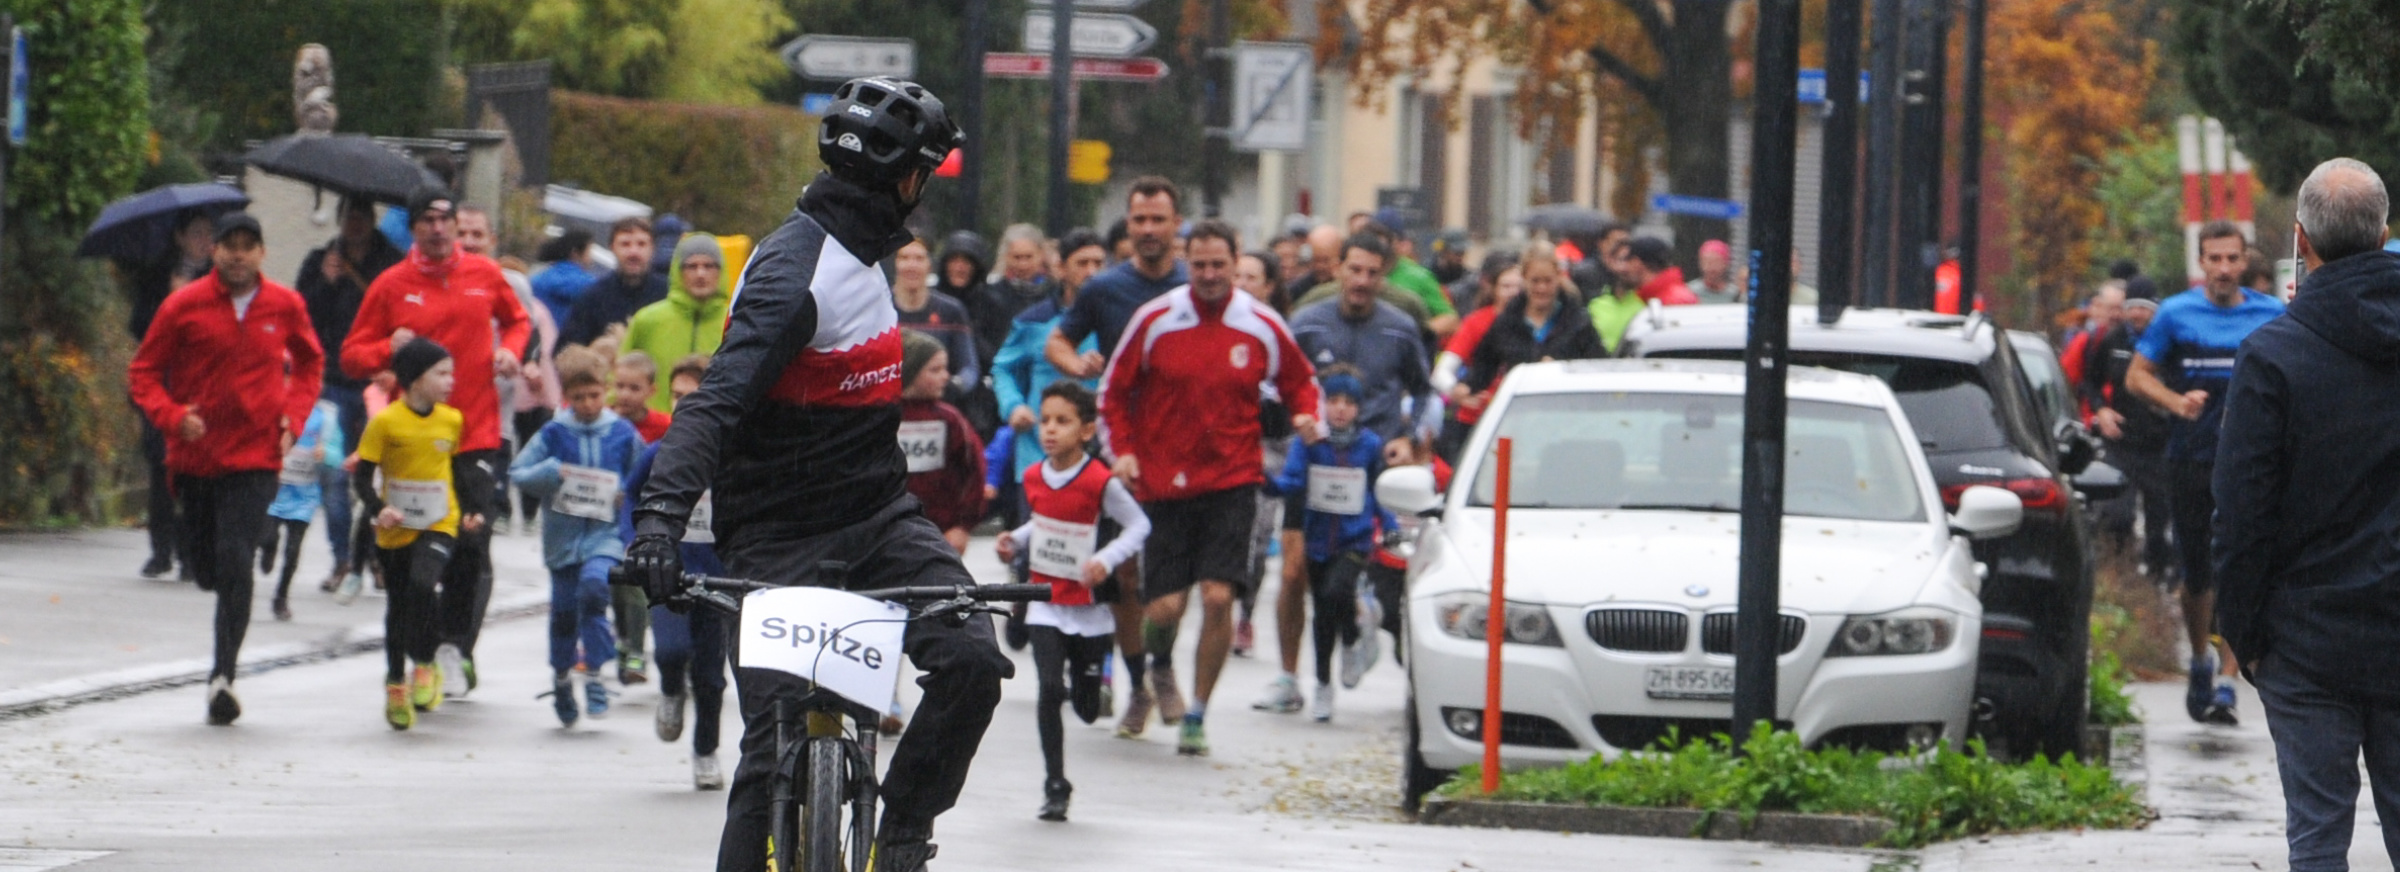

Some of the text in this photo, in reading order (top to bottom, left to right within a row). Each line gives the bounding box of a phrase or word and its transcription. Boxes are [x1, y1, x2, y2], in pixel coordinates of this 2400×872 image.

[760, 617, 883, 670] Spitze
[1651, 668, 1672, 689] ZH
[1711, 670, 1735, 691] 06
